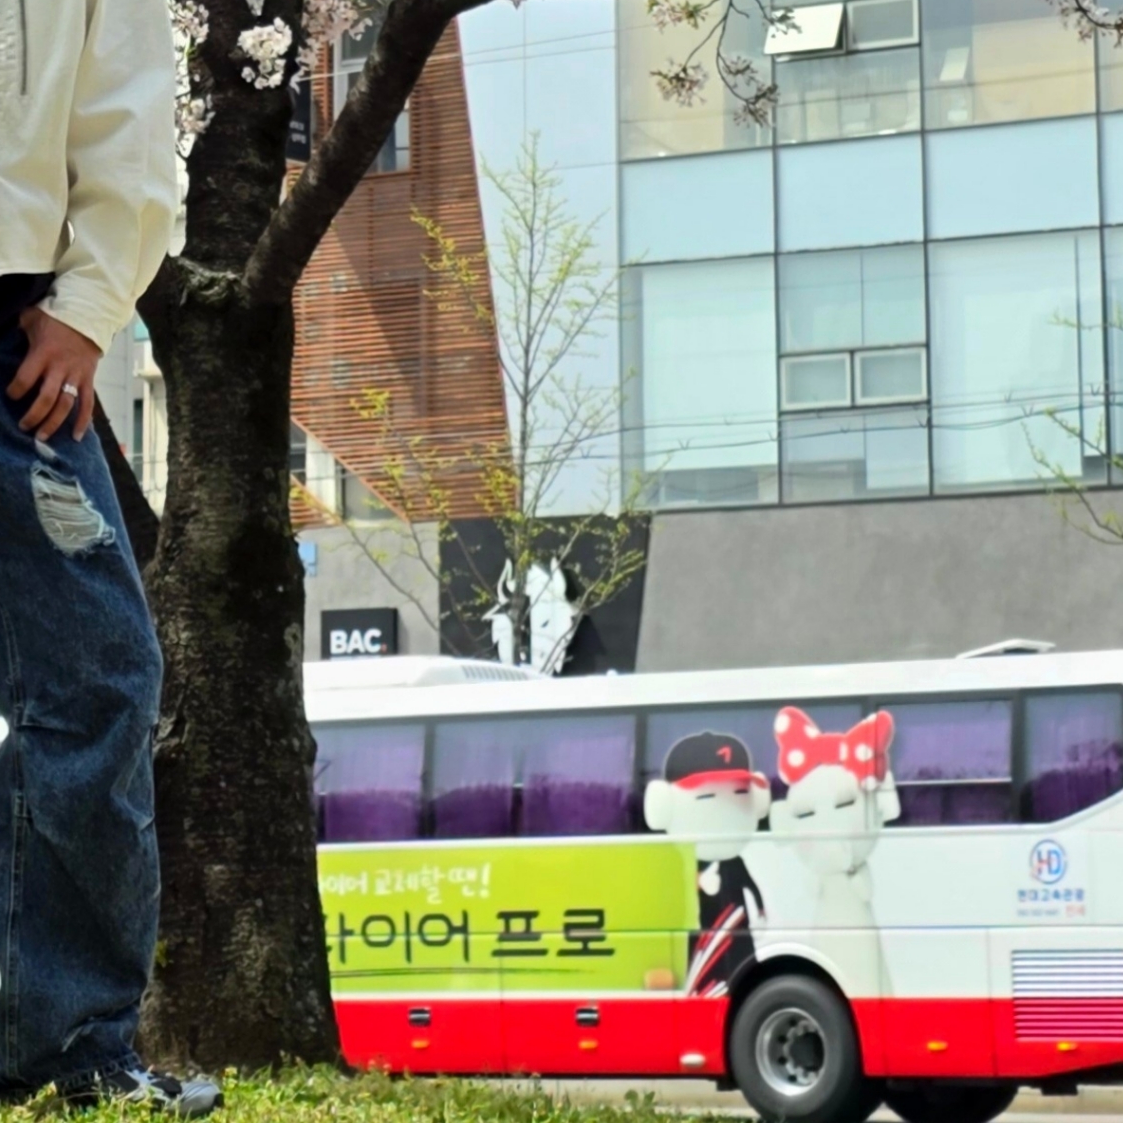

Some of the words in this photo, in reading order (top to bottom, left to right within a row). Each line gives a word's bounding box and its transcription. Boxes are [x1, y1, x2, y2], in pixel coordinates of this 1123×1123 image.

[318, 871, 367, 895] 이어
[374, 866, 444, 905] 교체할
[490, 908, 616, 958] 프로
